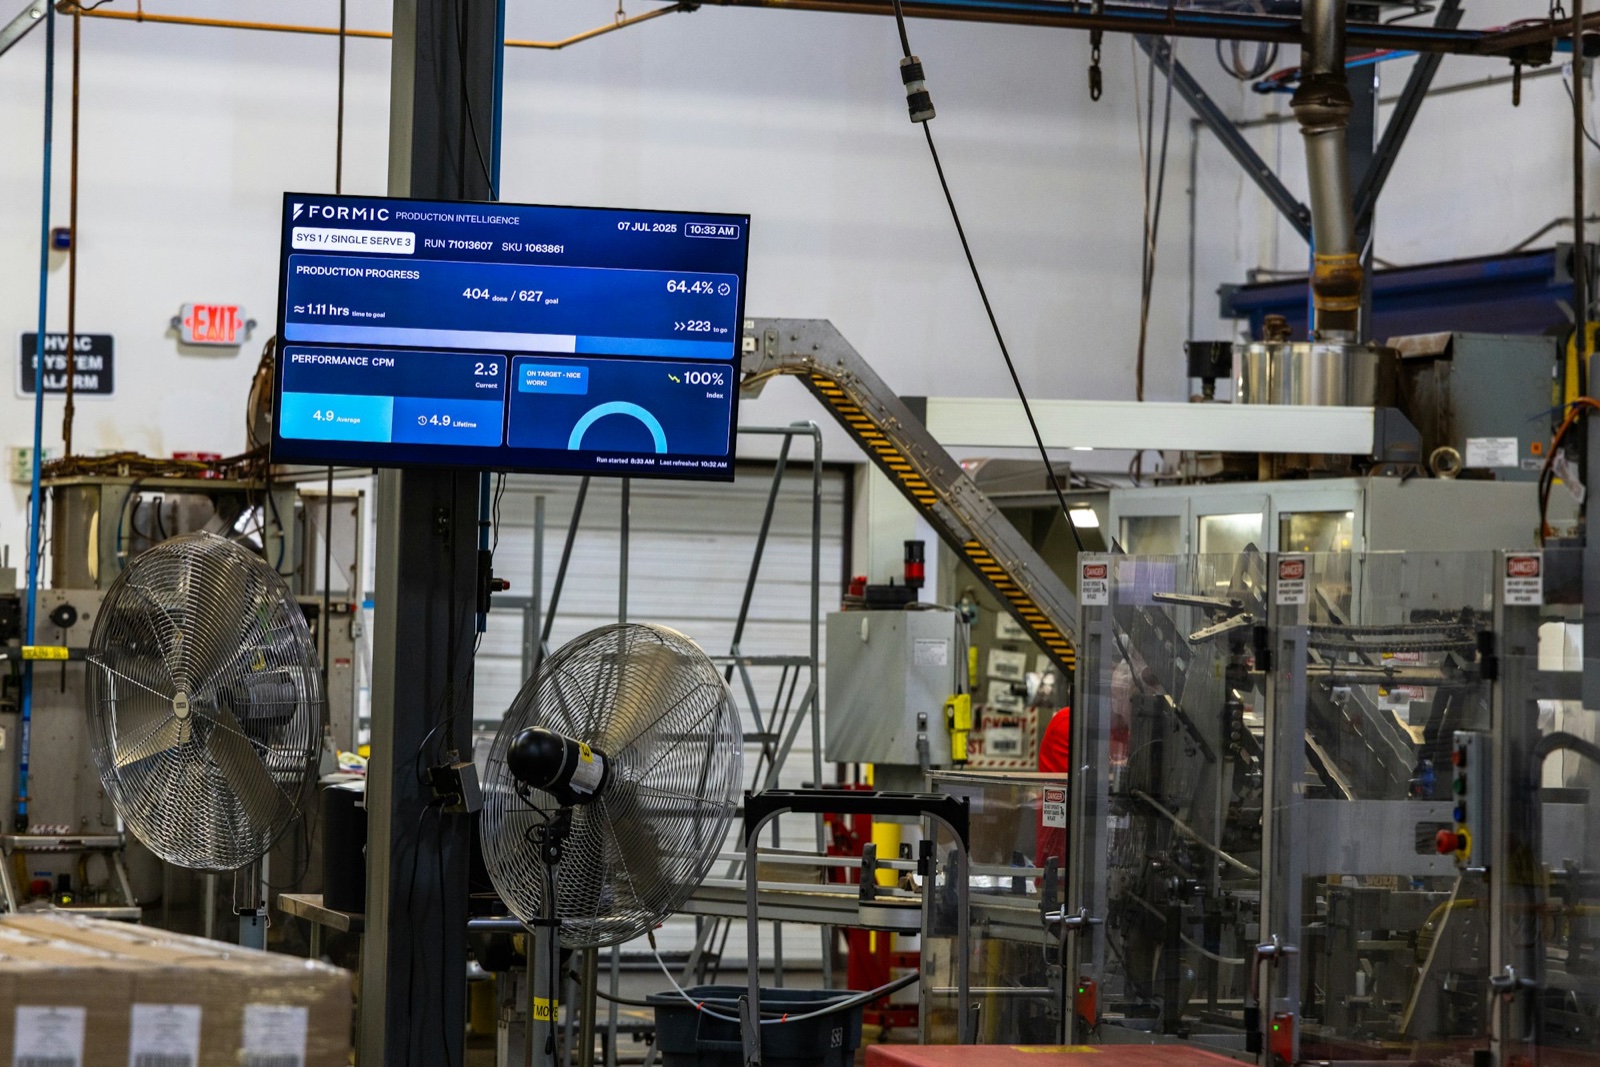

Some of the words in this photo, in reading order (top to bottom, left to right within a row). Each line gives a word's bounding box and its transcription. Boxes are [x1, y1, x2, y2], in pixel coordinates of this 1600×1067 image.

[309, 206, 389, 221] FORMIC
[396, 212, 454, 222] PRODUCTION
[456, 214, 520, 225] INTELLIGENCE
[618, 222, 630, 231] 07
[631, 223, 650, 232] JUL
[653, 224, 677, 233] 2025
[690, 226, 716, 235] 10:33
[717, 227, 734, 236] AM
[296, 233, 316, 242] SYS
[331, 235, 368, 244] SINGLE
[370, 236, 402, 246] SERVE
[404, 238, 411, 246] 3
[424, 239, 445, 248] RUN
[448, 240, 493, 250] 71013607
[502, 242, 522, 251] SKU
[525, 244, 564, 253] 1063861
[296, 266, 363, 277] PRODUCTION
[365, 269, 420, 279] PROGRESS
[666, 280, 714, 294] 64.4%
[463, 288, 490, 299] 404
[519, 291, 543, 302] 627
[307, 304, 326, 315] 1.11
[329, 304, 349, 316] hrs
[192, 306, 237, 342] EXIT
[687, 320, 711, 332] 223
[292, 354, 368, 366] PERFORMANCE
[372, 358, 394, 367] CPM
[474, 363, 498, 376] 2.3
[684, 371, 724, 386] 100%
[313, 410, 334, 421] 4.9
[336, 416, 361, 424] Average
[430, 414, 450, 426] 4.9
[536, 1005, 558, 1017] MOE
